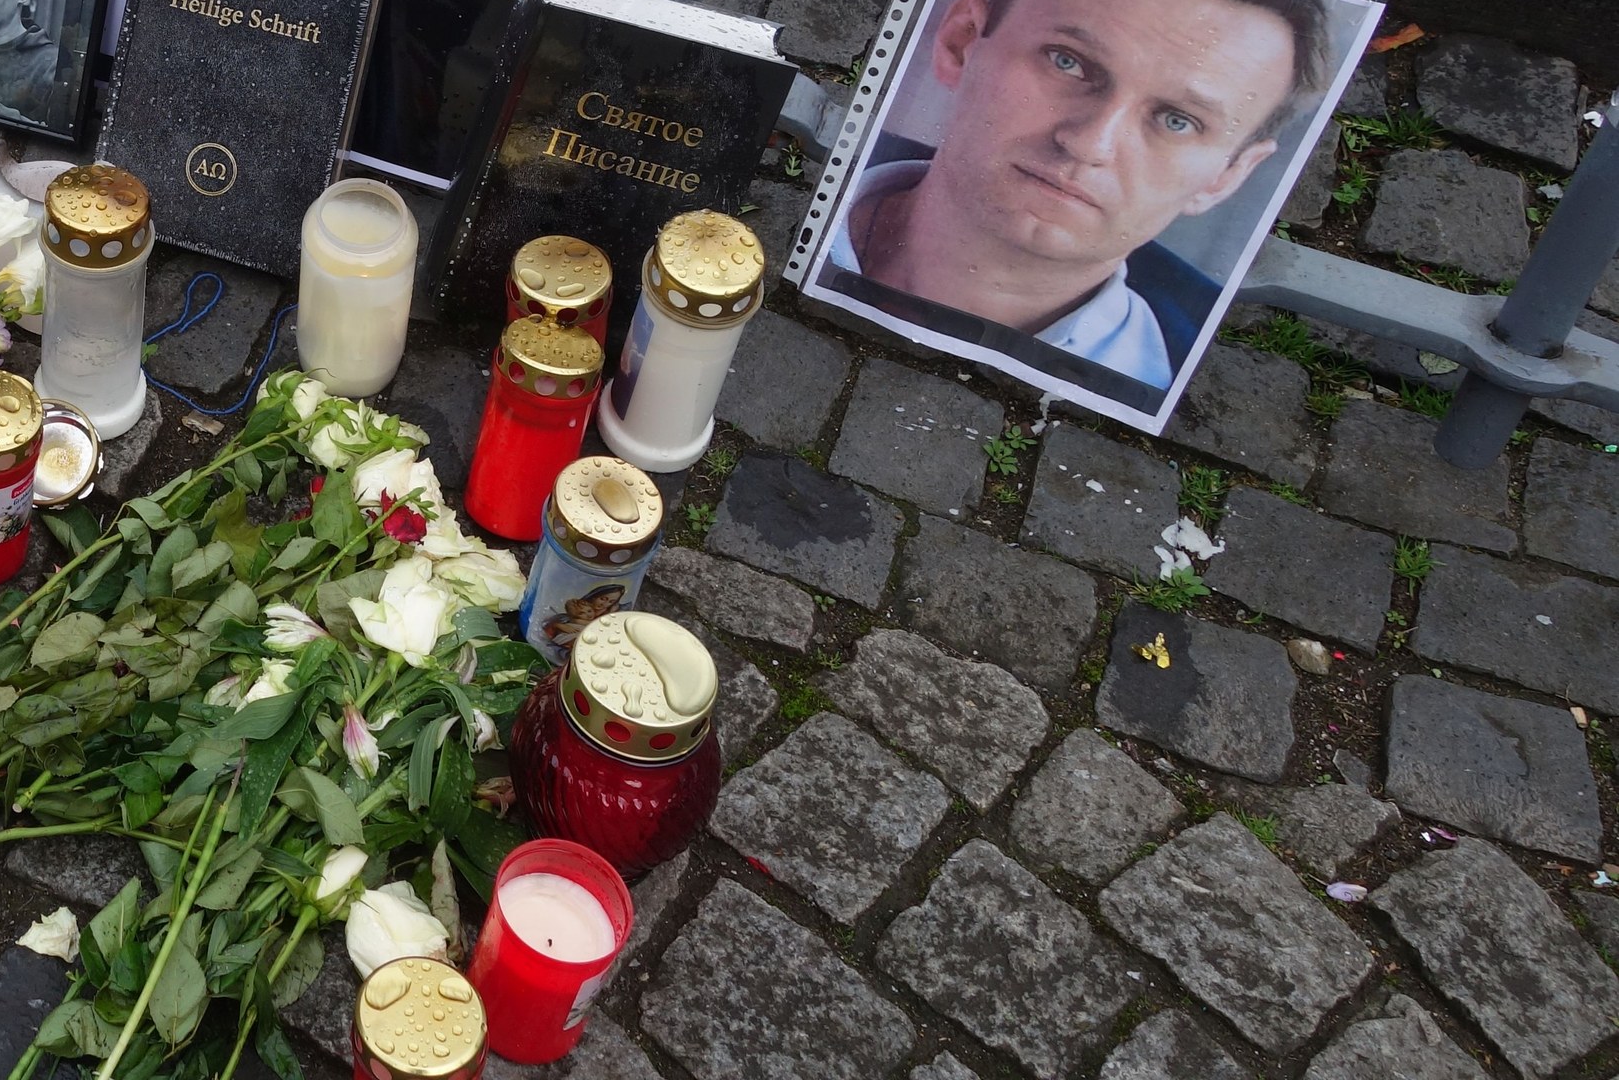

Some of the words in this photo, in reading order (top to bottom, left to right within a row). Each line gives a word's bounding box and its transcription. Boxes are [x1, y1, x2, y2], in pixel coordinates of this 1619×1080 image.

[248, 9, 322, 45] Schrift
[576, 91, 704, 148] Святое
[542, 127, 701, 194] Писание
